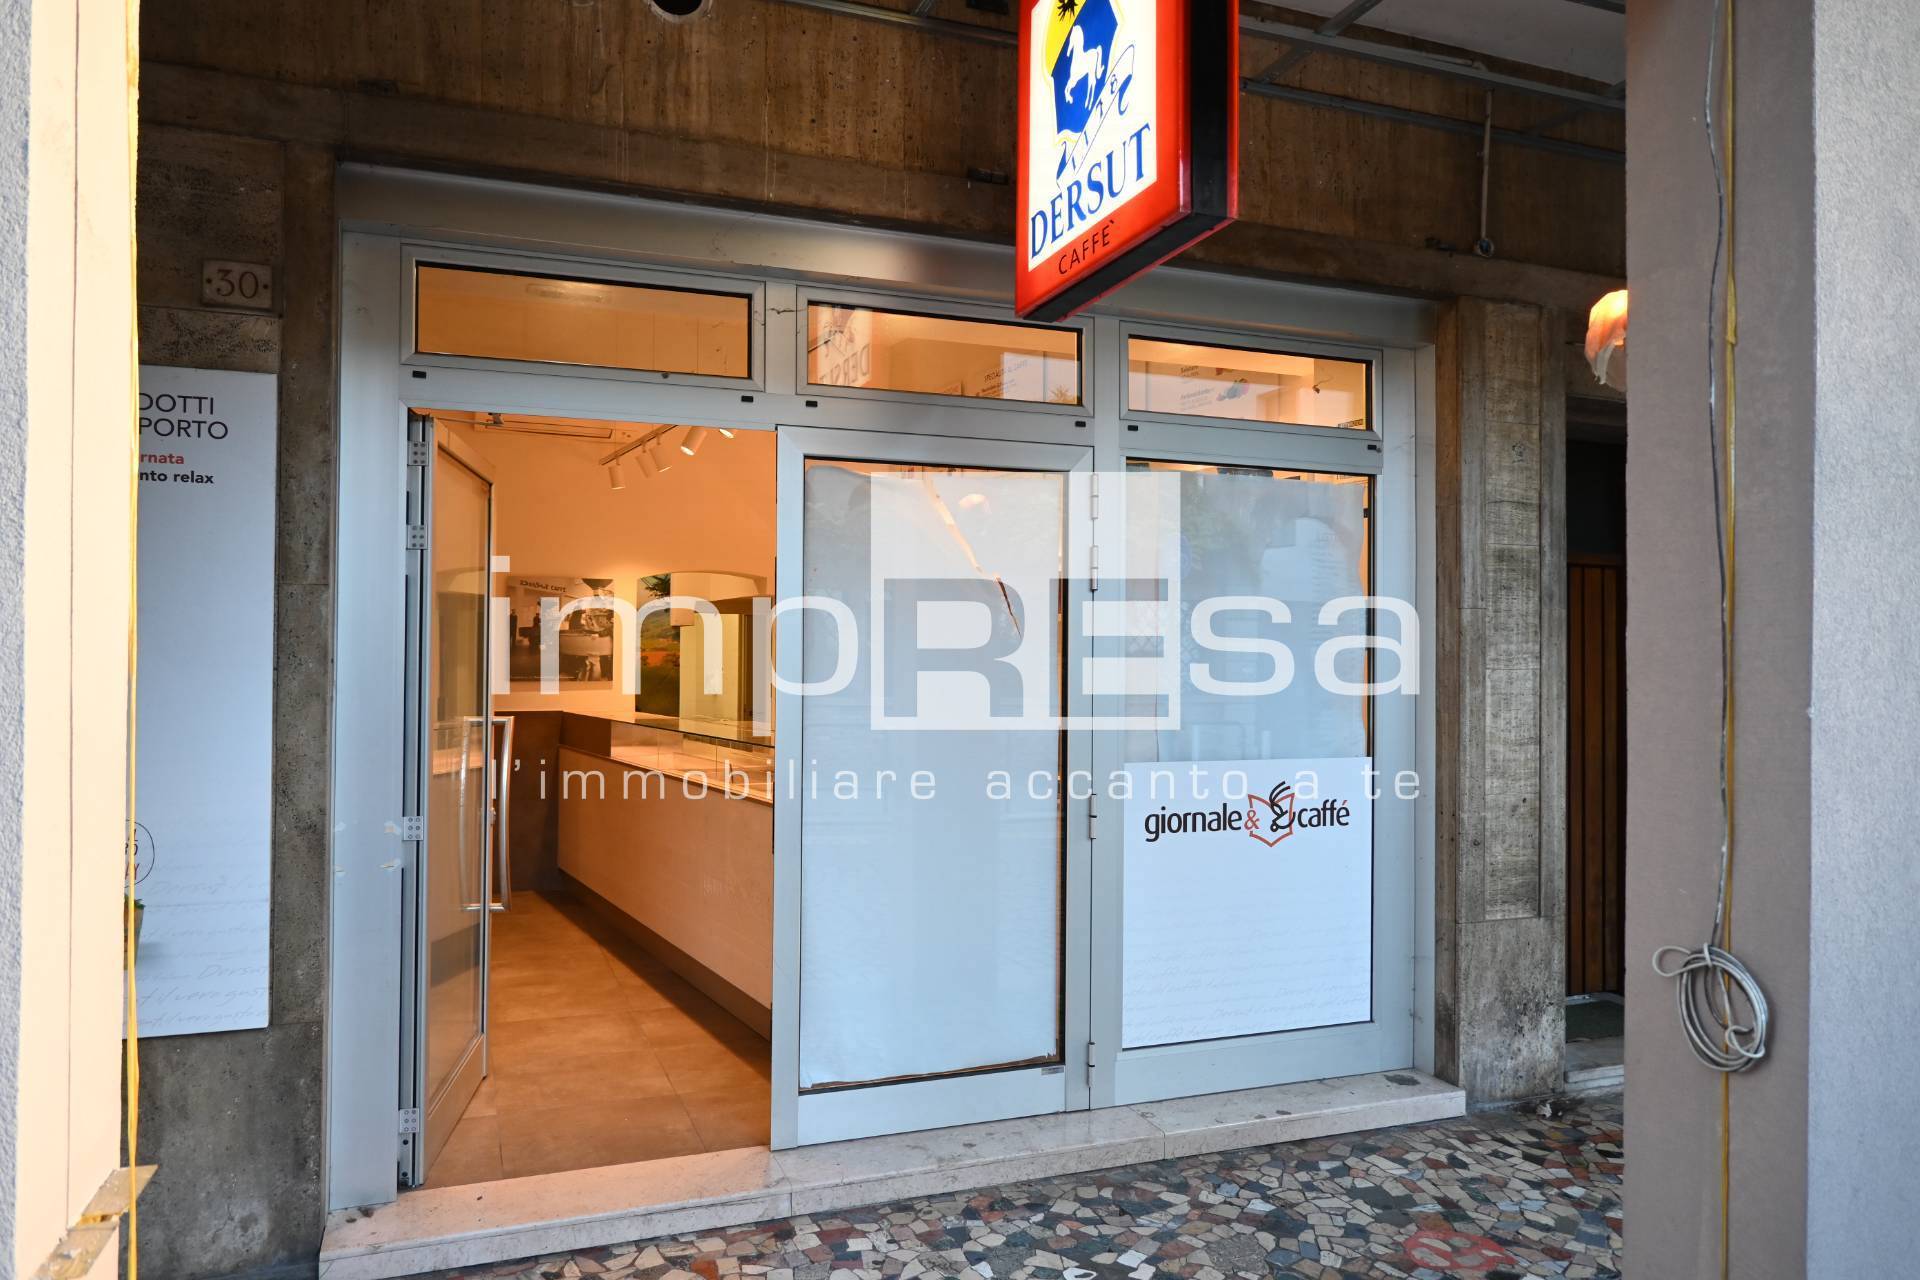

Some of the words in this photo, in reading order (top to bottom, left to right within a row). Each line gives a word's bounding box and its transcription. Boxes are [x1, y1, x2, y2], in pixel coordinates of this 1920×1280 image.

[1031, 123, 1151, 259] DERSUT
[216, 268, 259, 299] 30
[138, 417, 228, 440] PORTO
[173, 470, 214, 484] relax
